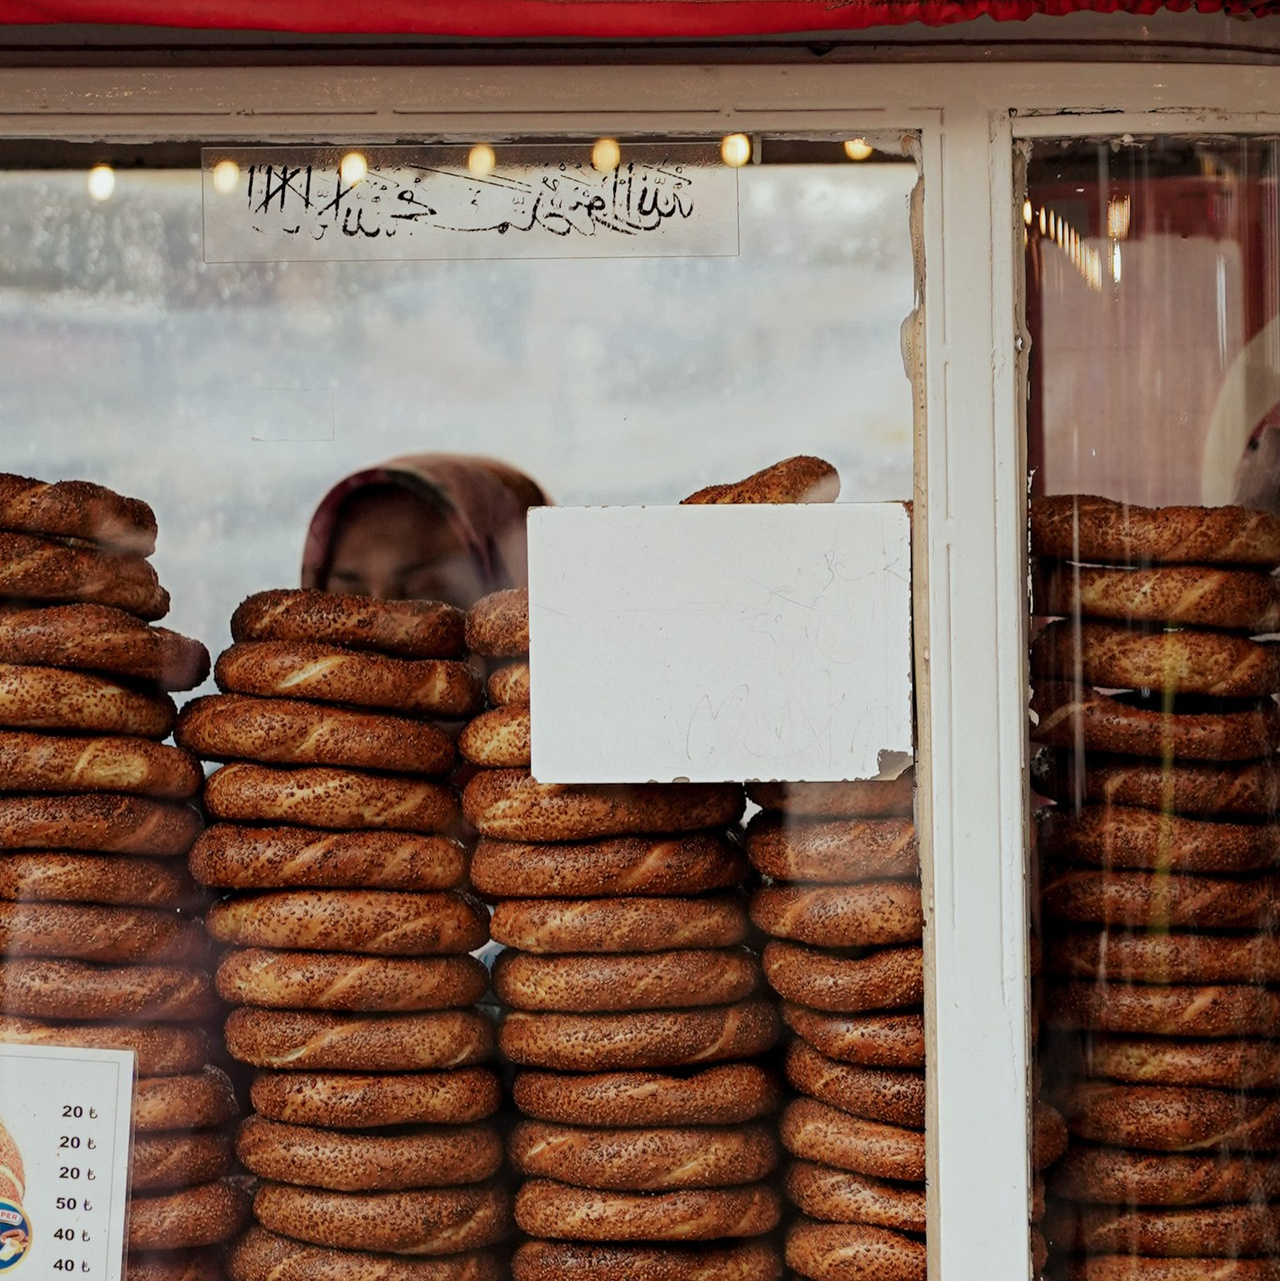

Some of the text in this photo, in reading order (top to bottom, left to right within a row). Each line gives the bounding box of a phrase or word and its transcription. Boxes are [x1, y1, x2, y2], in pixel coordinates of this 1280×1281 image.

[62, 1105, 83, 1118] 20
[60, 1136, 80, 1149] 20
[59, 1166, 80, 1180] 20
[56, 1197, 77, 1210] 50
[53, 1228, 75, 1241] 40
[53, 1259, 74, 1272] 40
